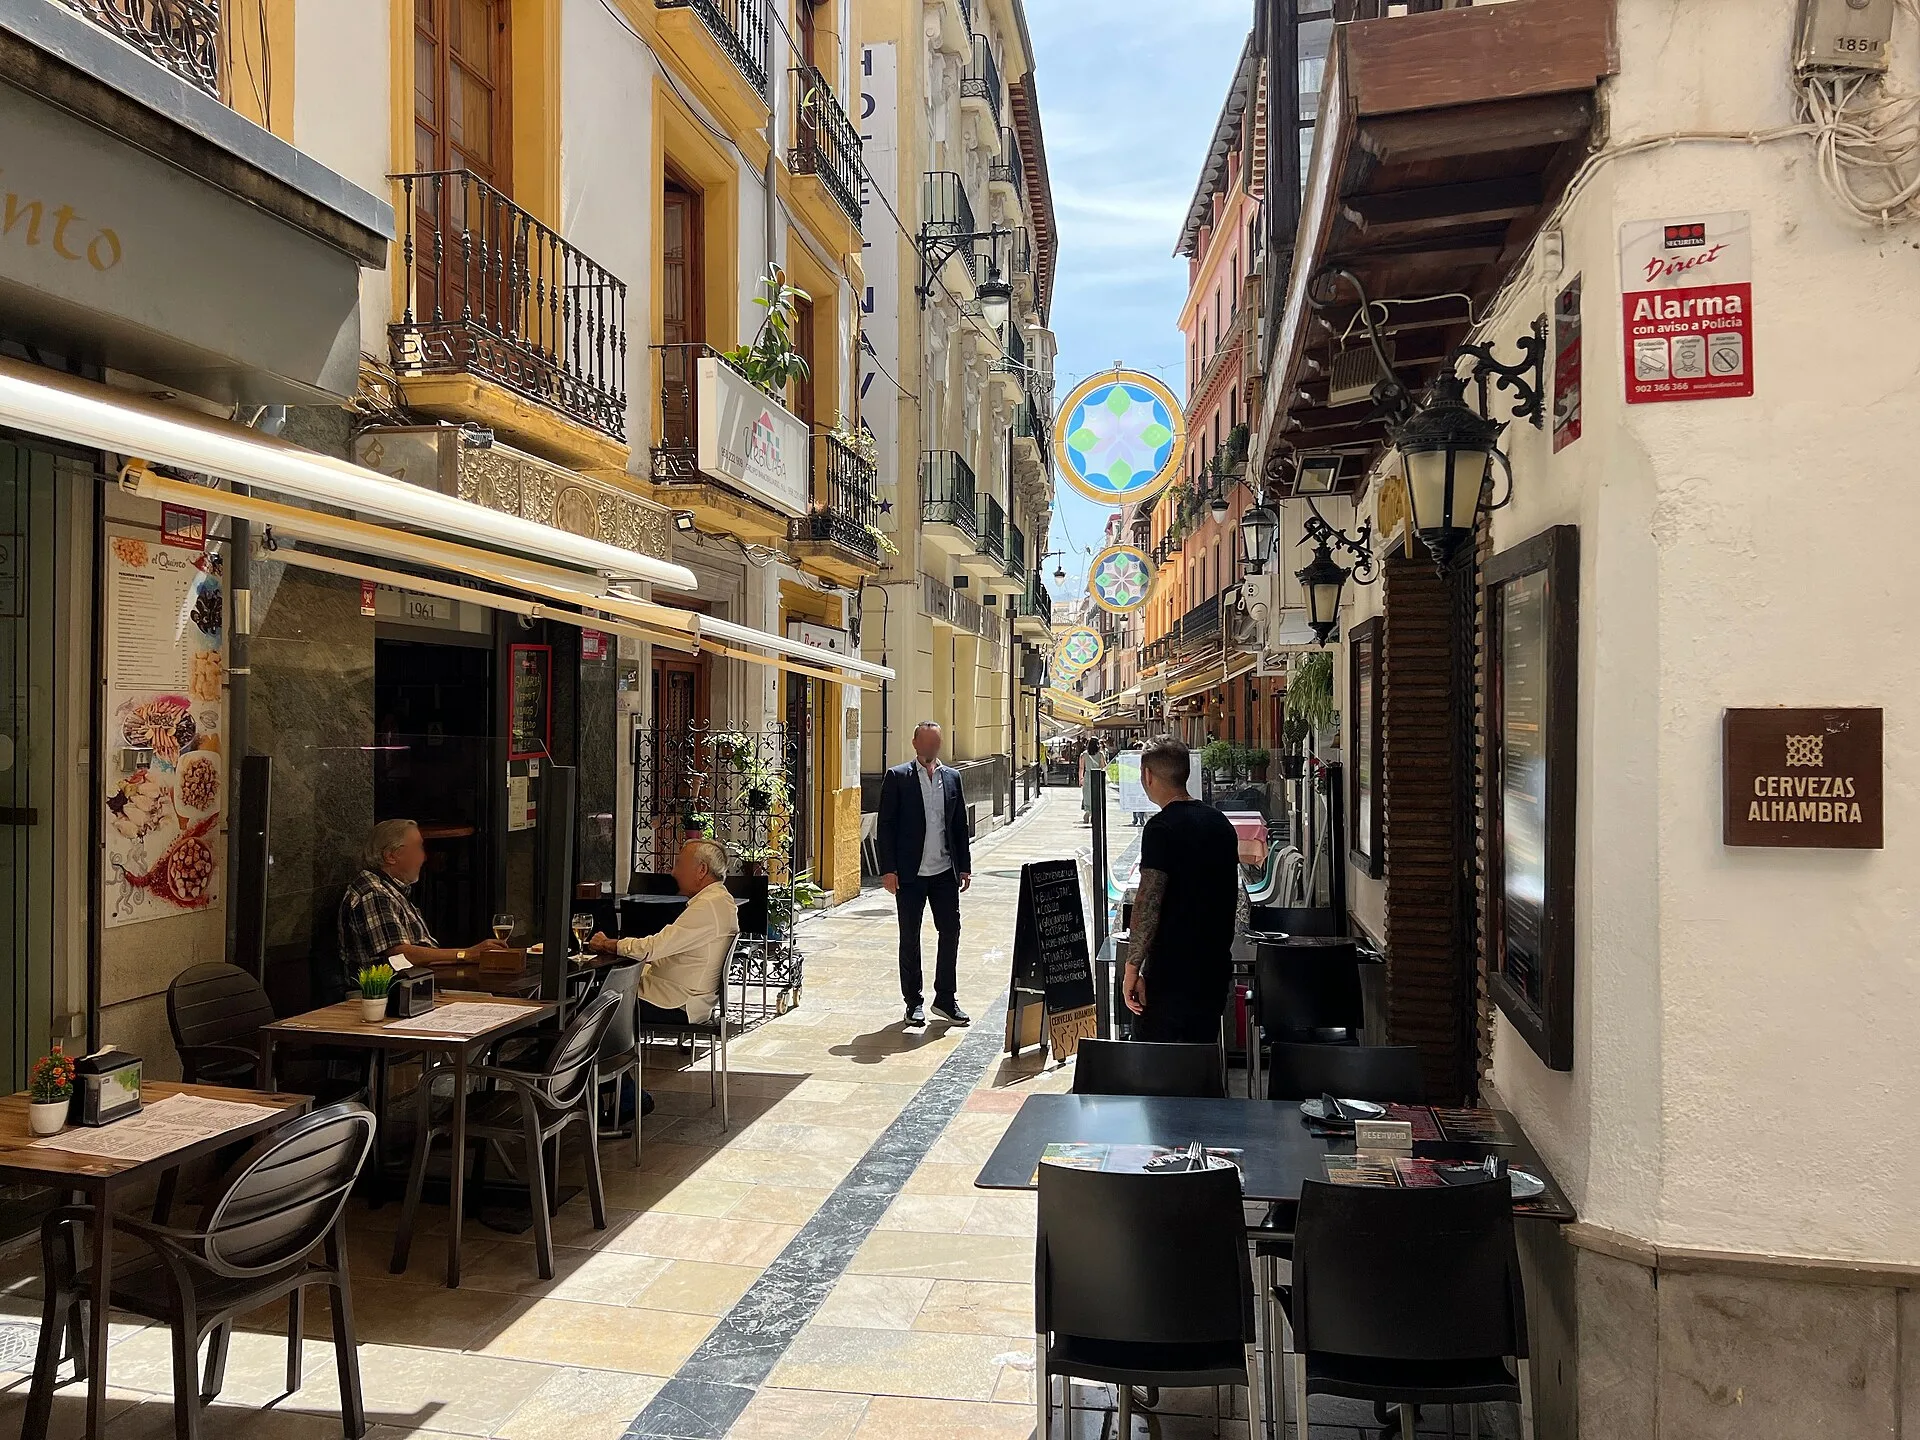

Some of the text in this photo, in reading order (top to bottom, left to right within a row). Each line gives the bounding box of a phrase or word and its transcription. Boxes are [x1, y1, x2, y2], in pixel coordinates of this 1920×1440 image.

[0, 192, 122, 272] nto
[1665, 238, 1704, 247] SECURITAS
[1642, 243, 1731, 283] Direct
[1633, 295, 1743, 321] Alarma
[1633, 316, 1743, 335] con aviso a Policía
[1635, 382, 1689, 393] 902 366 366
[158, 551, 187, 569] Quinto
[410, 601, 435, 620] 1961
[1754, 776, 1856, 798] CERVEZAS
[1748, 801, 1863, 823] ALHAMBRA
[1051, 1013, 1073, 1026] CERVEZAS
